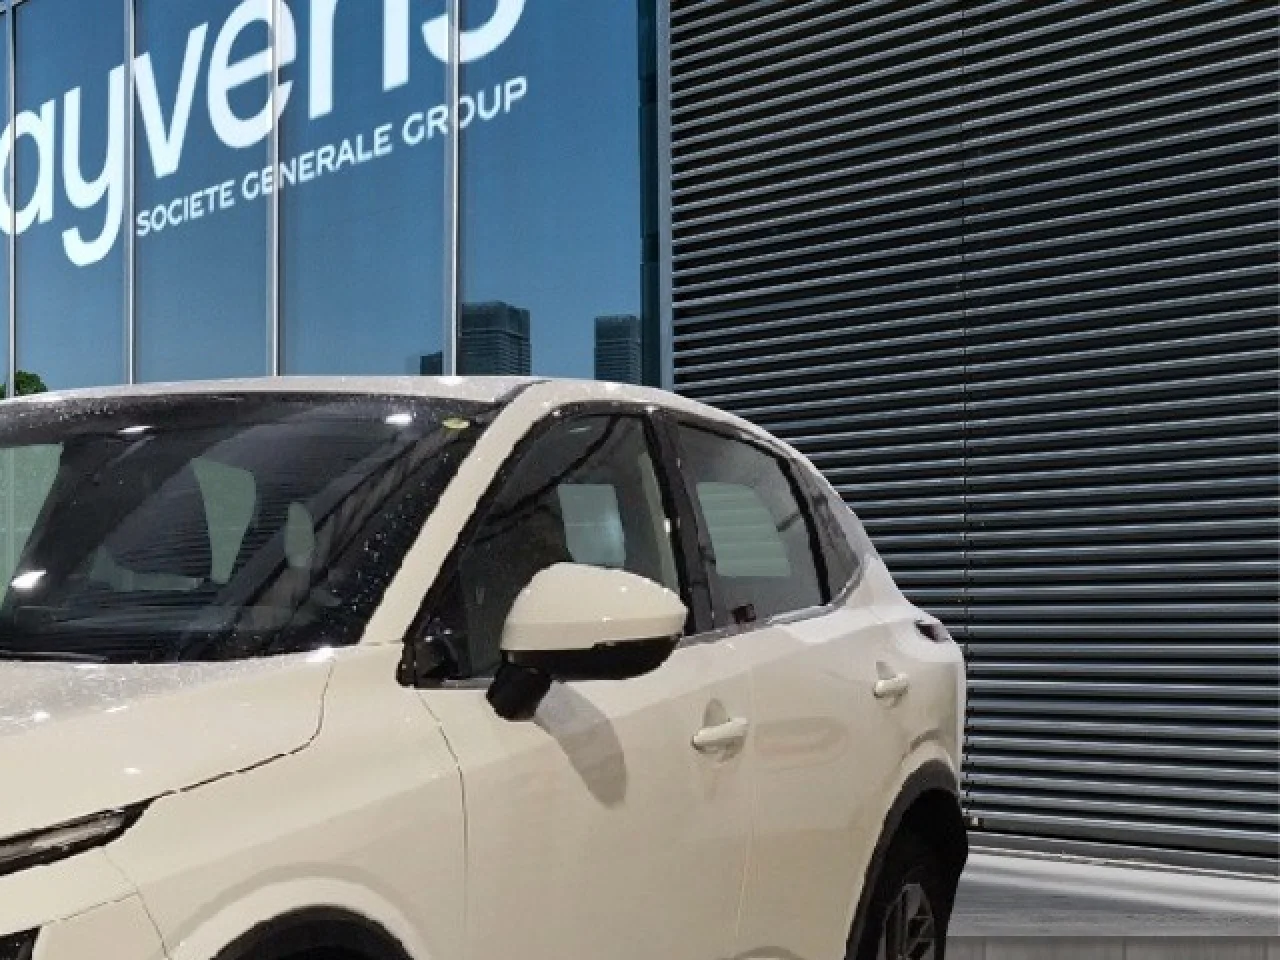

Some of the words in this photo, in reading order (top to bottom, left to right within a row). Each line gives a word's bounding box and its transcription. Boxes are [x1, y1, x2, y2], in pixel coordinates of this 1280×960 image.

[135, 179, 236, 237] SOCIETE
[241, 123, 393, 201] GENERALE
[401, 75, 528, 146] GROUP
